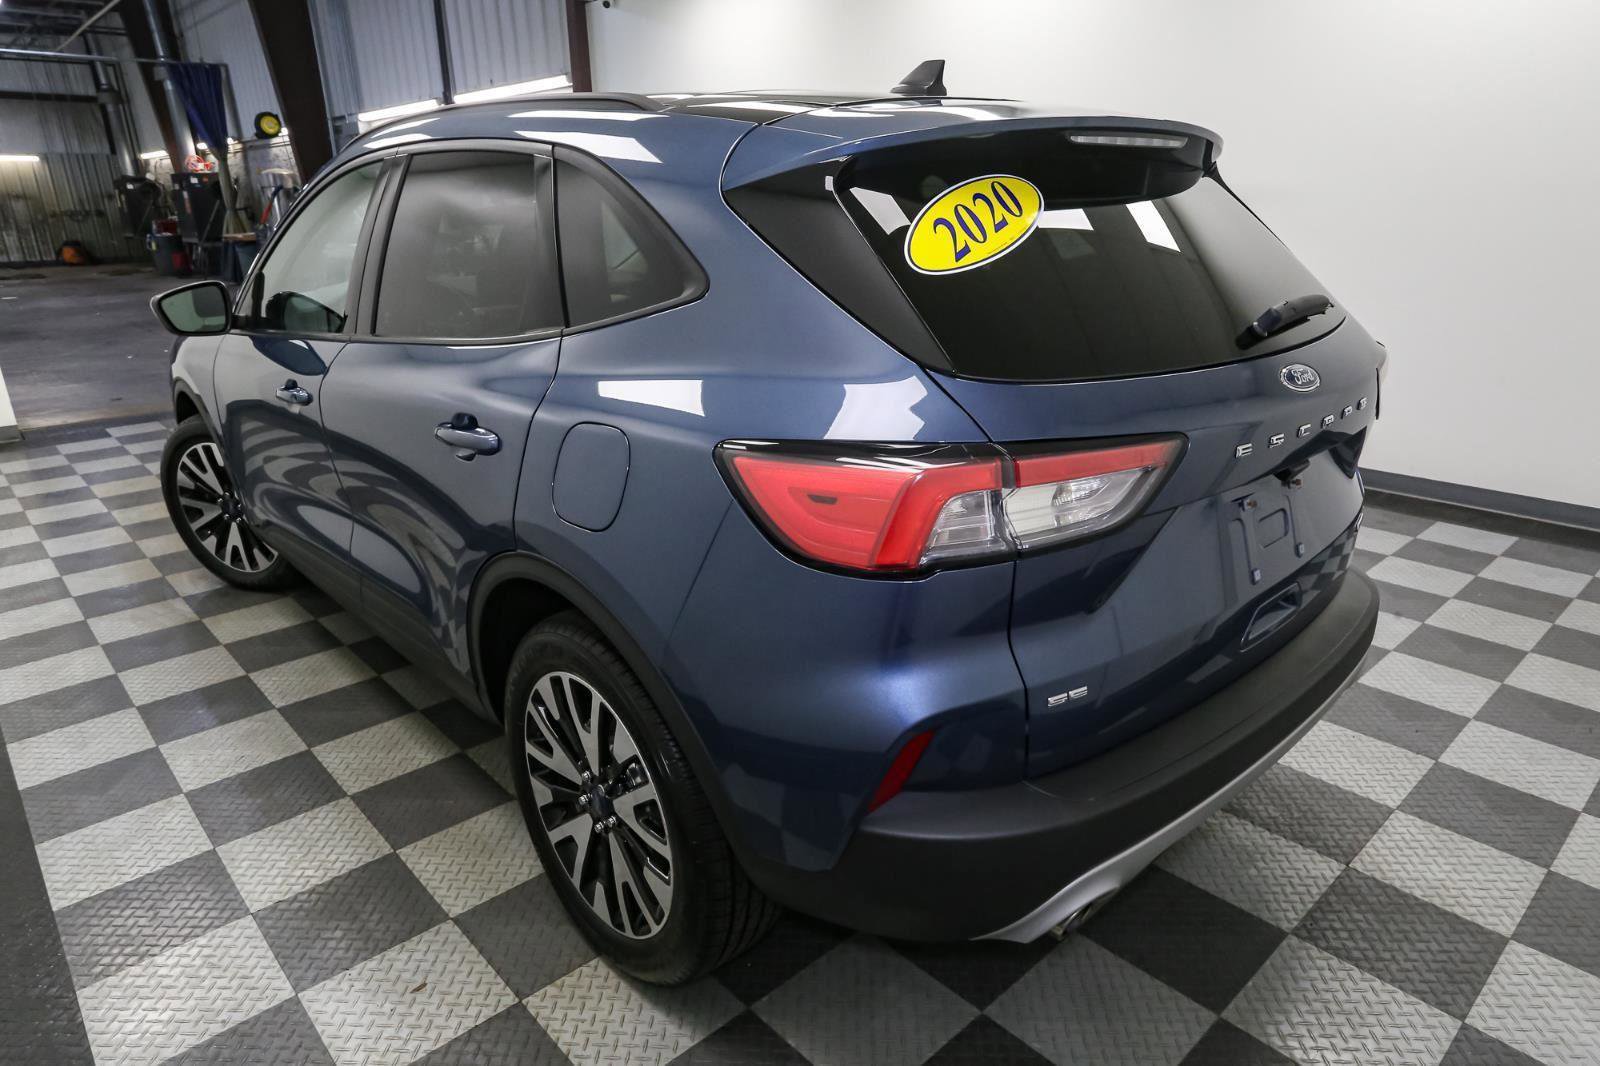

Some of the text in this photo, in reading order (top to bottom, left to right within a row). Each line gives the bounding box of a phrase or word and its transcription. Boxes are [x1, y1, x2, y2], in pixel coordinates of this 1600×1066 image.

[933, 181, 1023, 263] 2020
[1235, 397, 1368, 458] ESCAPE
[1047, 686, 1088, 707] SE
